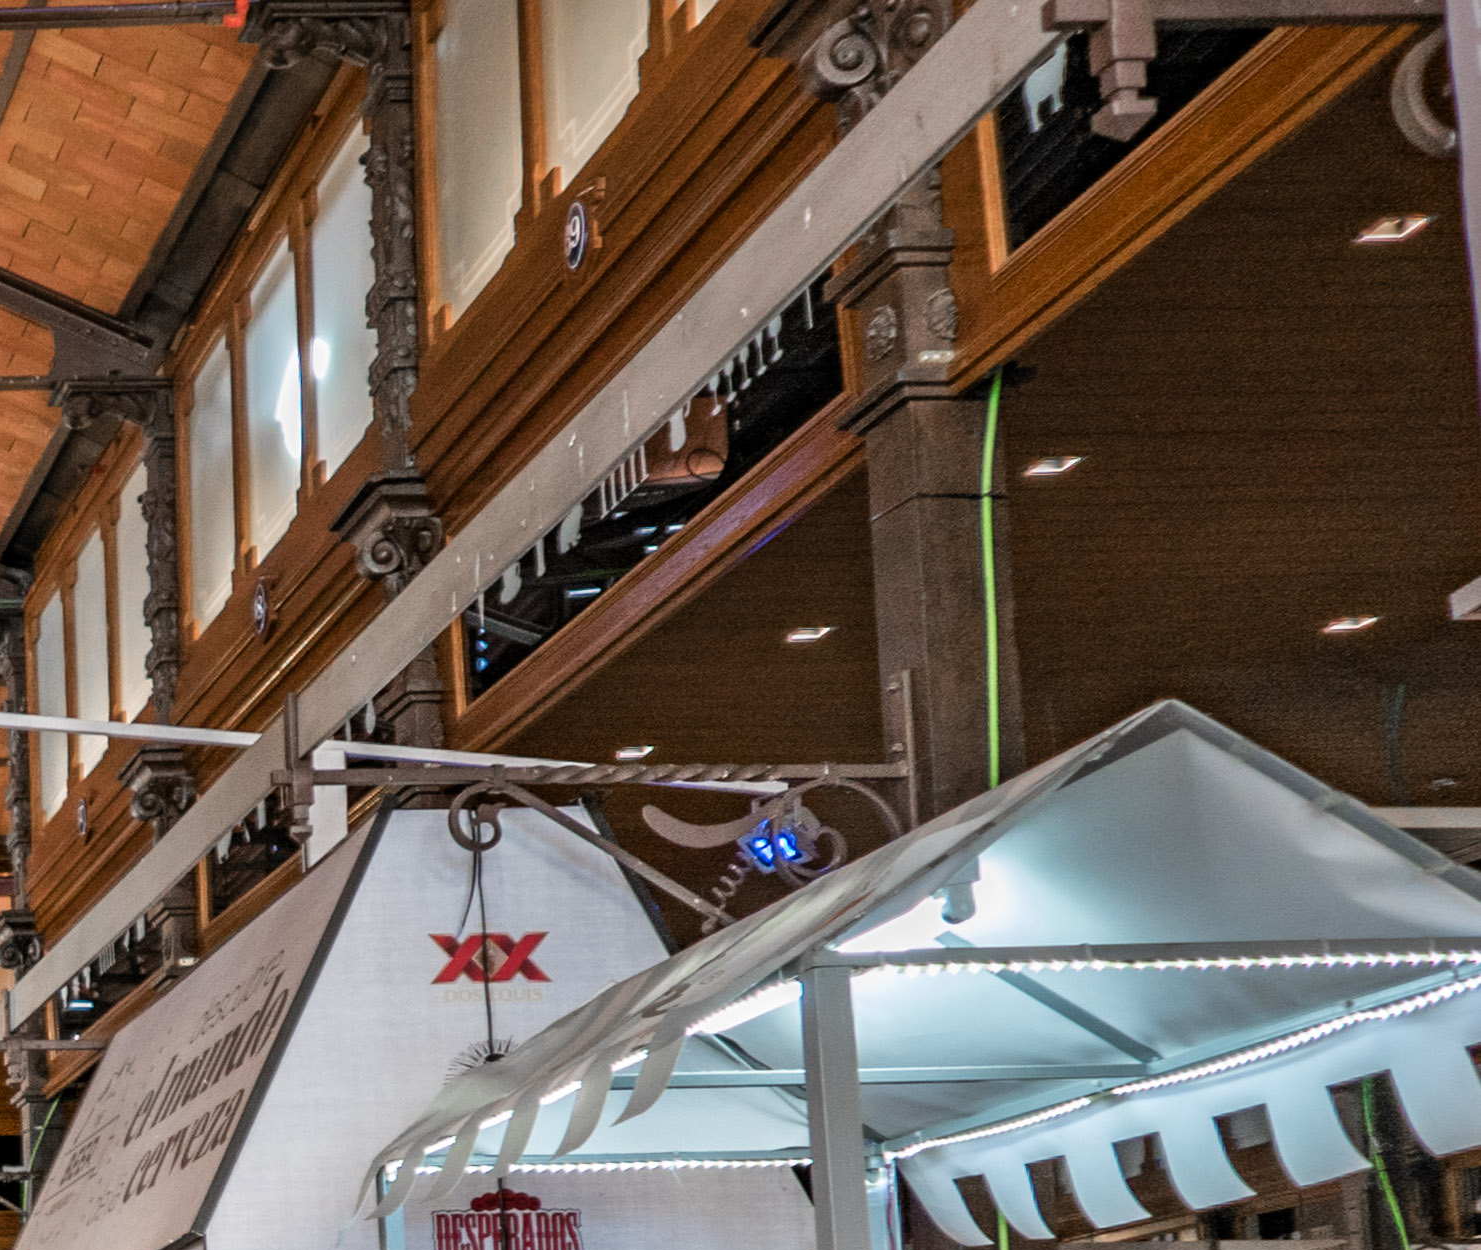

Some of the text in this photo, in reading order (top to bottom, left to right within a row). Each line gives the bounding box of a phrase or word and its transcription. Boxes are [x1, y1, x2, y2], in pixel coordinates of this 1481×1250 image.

[428, 931, 552, 984] XX
[123, 971, 289, 1148] el mundo
[123, 1087, 245, 1205] cerveza
